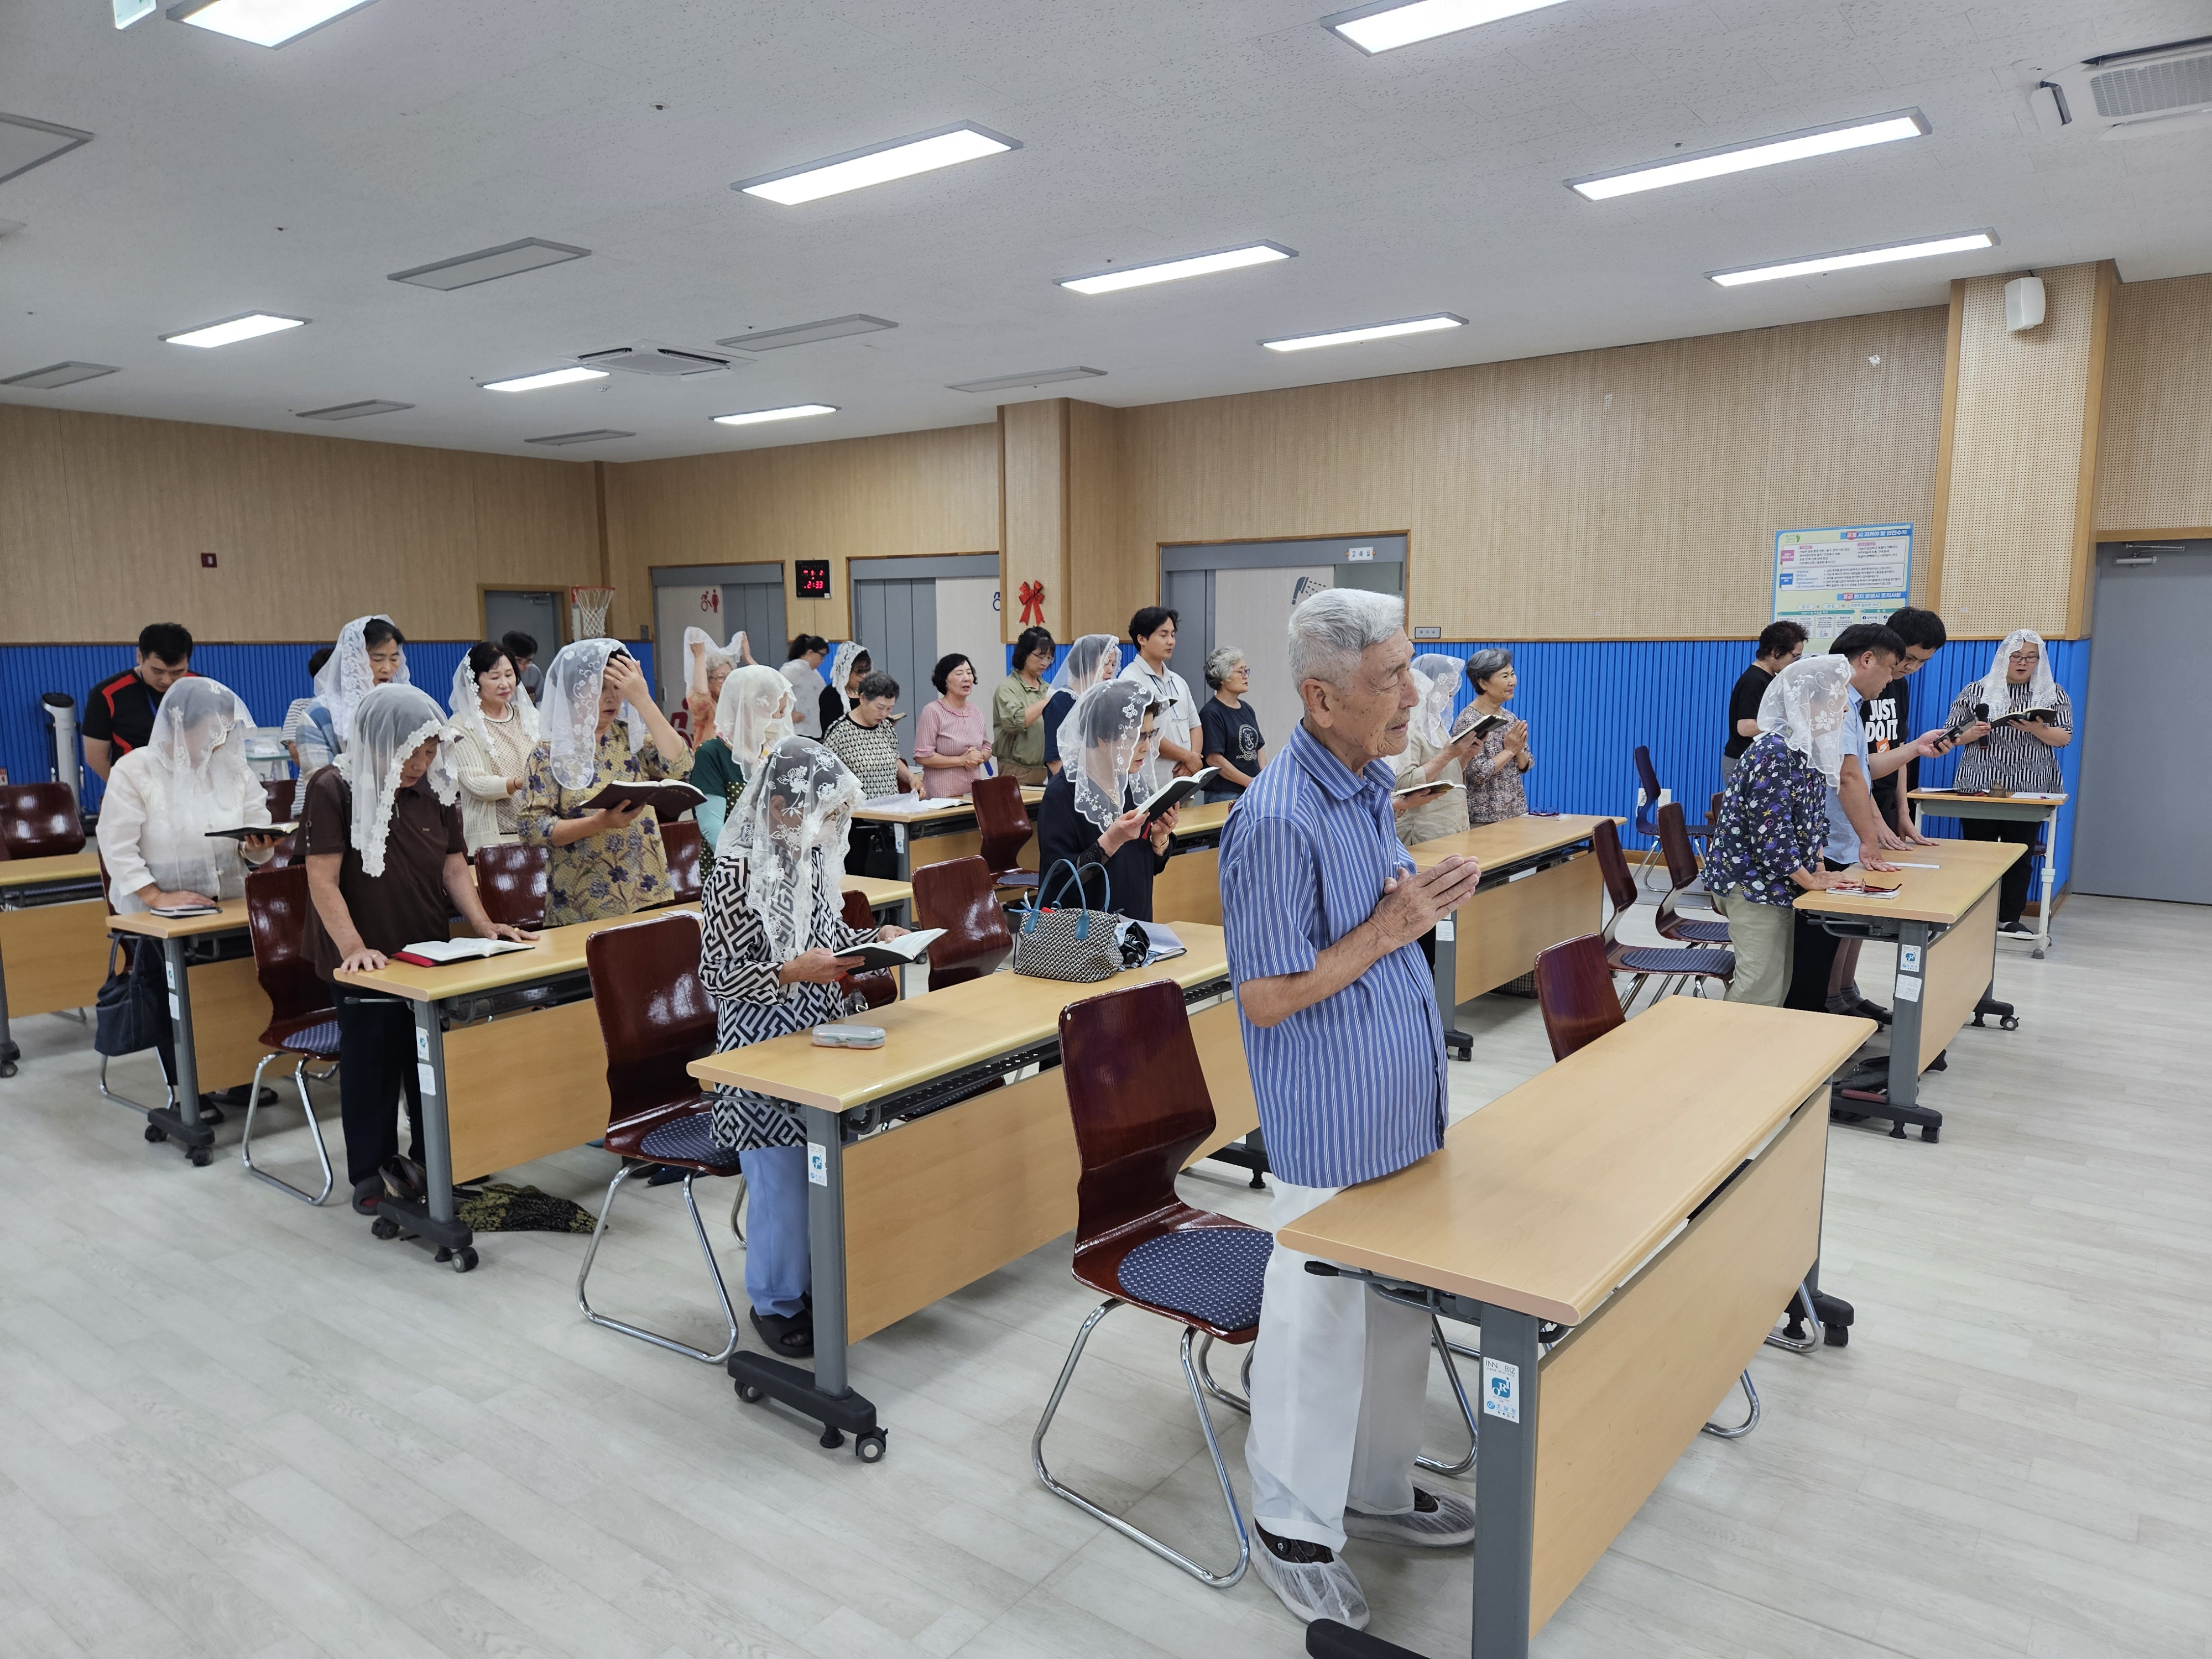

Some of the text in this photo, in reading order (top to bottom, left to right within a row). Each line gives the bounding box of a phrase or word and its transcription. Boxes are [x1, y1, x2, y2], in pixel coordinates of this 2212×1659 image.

[1869, 698, 1897, 721] JUST
[1865, 721, 1885, 743] DO
[1505, 1365, 1516, 1374] BIZ
